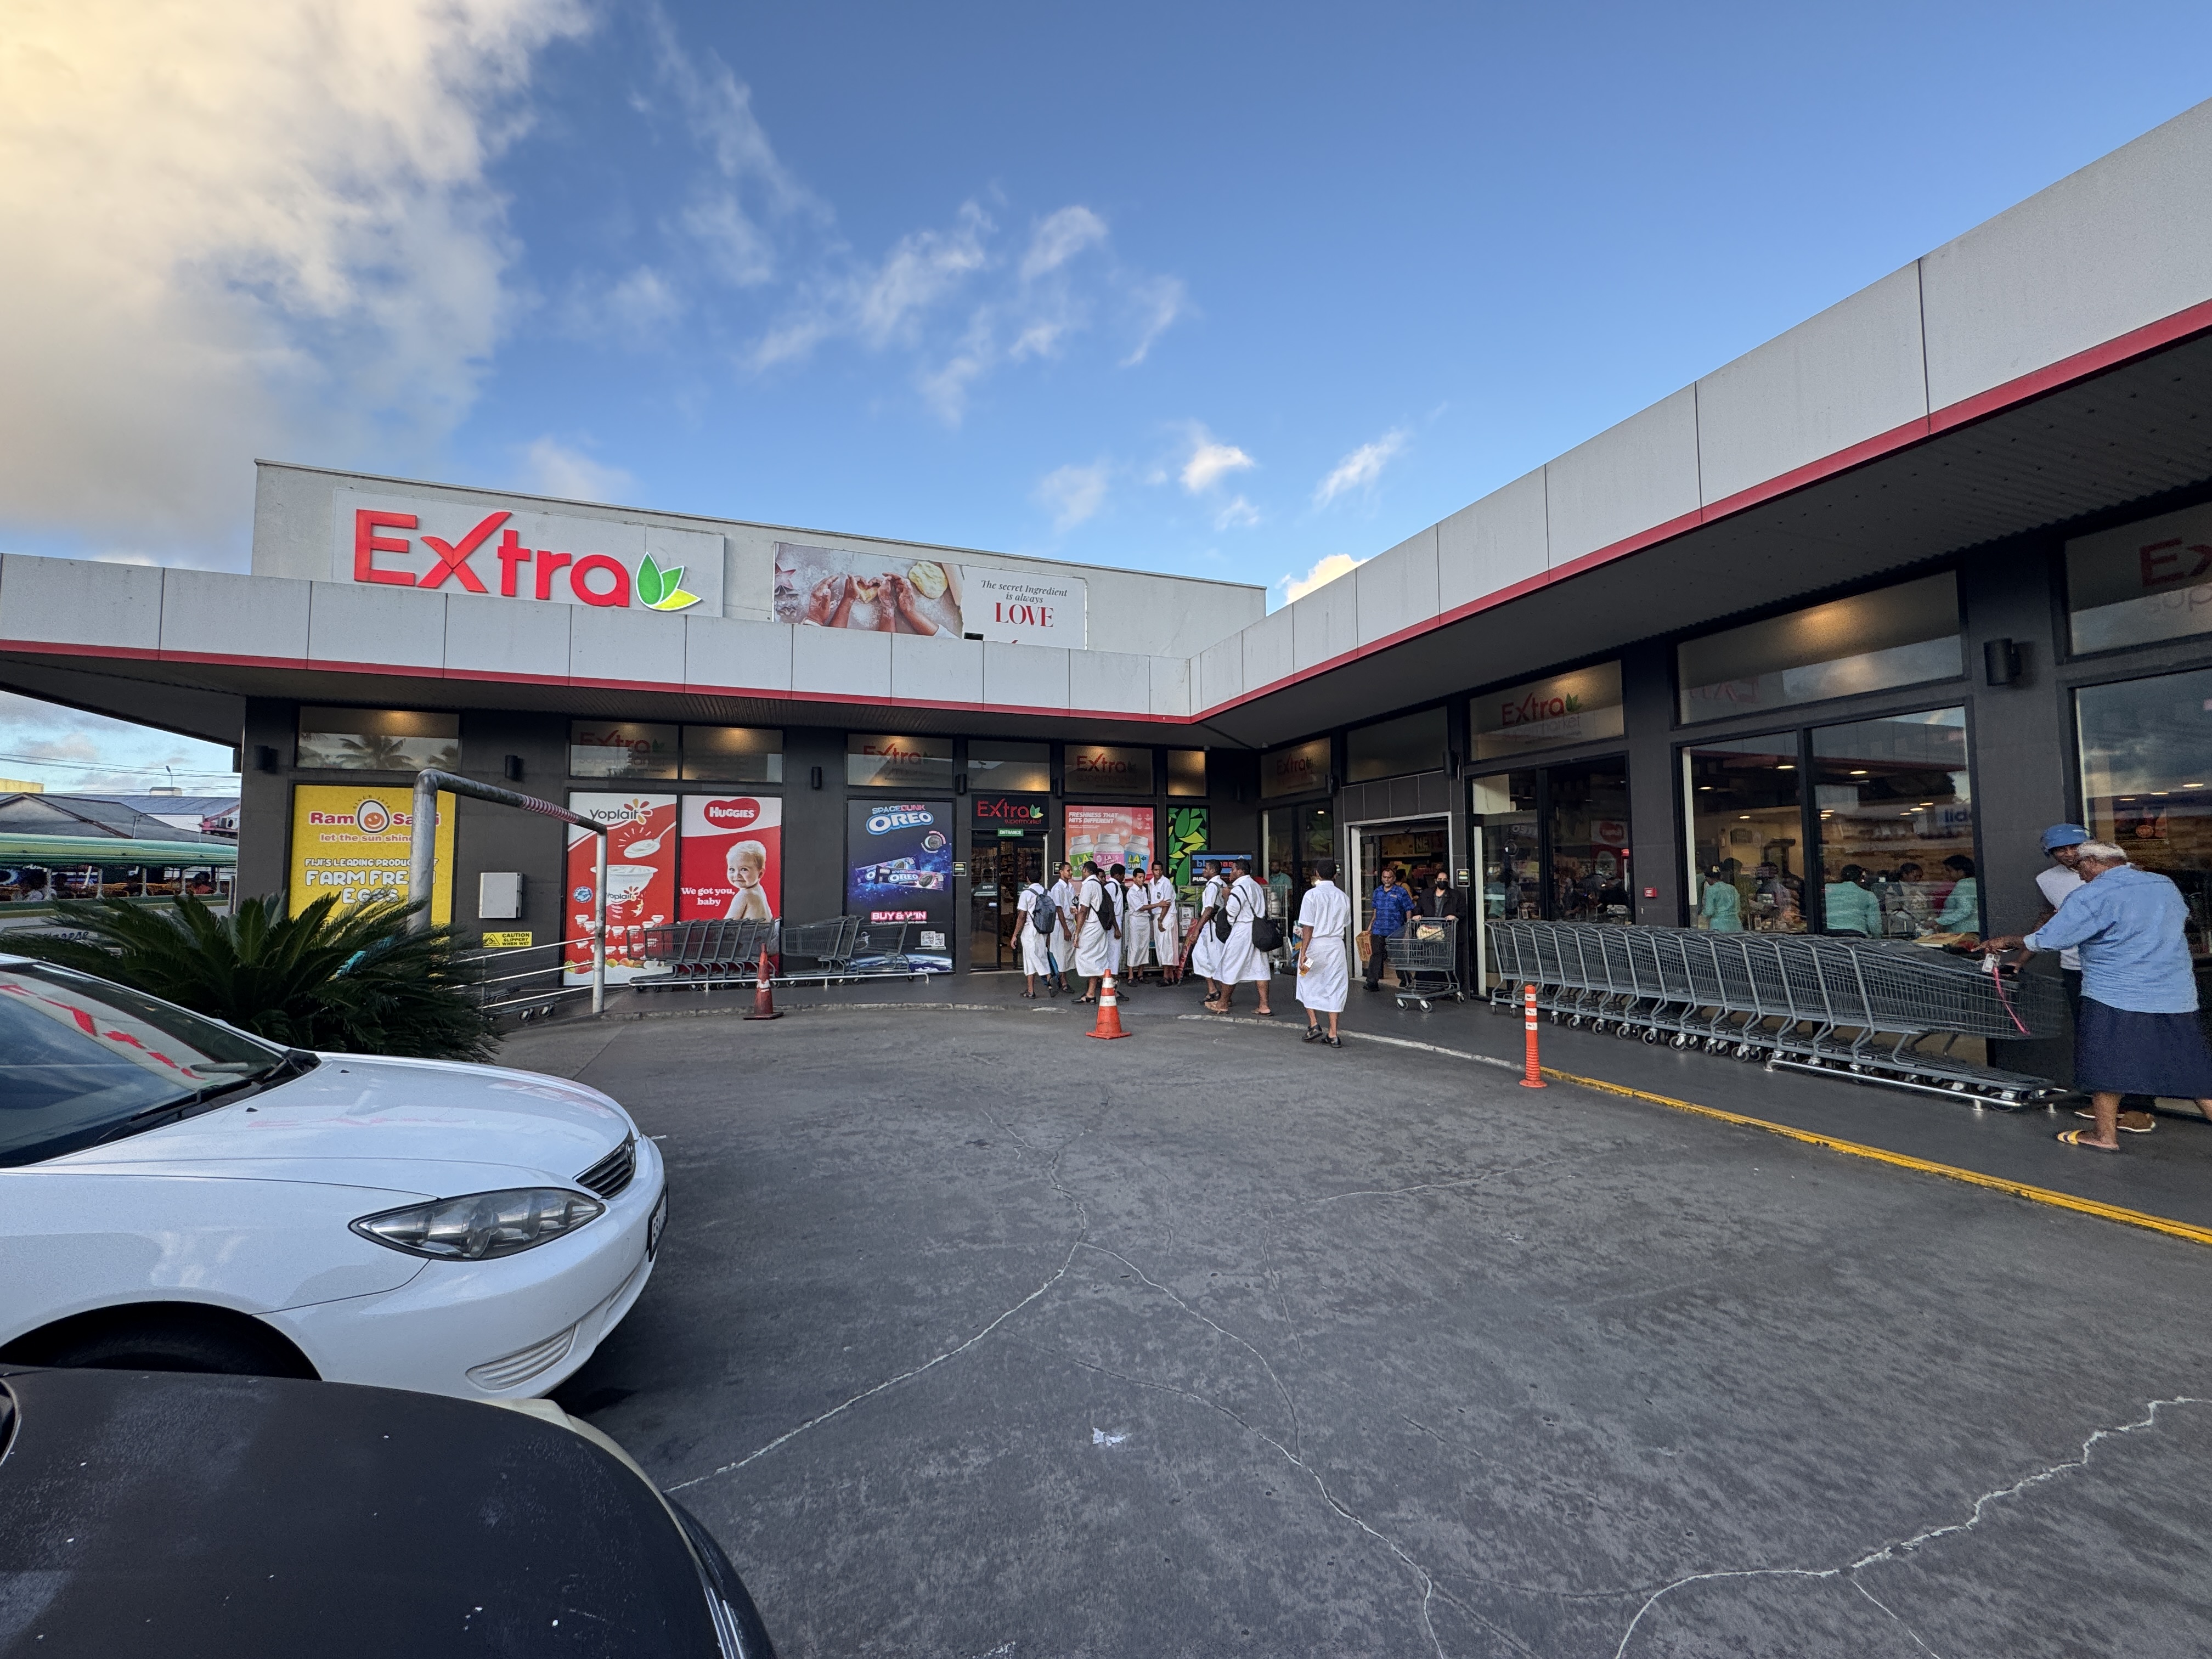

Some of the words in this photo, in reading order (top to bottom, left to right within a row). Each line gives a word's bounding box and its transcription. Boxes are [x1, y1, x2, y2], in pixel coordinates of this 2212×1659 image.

[354, 509, 630, 607] Extra
[981, 580, 996, 589] The
[998, 583, 1023, 592] secret
[1025, 585, 1068, 597] Ingredient
[1006, 592, 1013, 600] is
[1015, 593, 1043, 604] always
[995, 602, 1054, 628] LOVE
[1501, 692, 1564, 726] Extra
[1076, 753, 1127, 773] Extra
[709, 806, 755, 818] HUGGIES
[977, 798, 1030, 819] Extra
[311, 812, 354, 824] Ram
[589, 809, 639, 821] Yoplait
[869, 812, 932, 832] OREO
[1077, 854, 1089, 866] LA
[1128, 854, 1140, 863] LA
[306, 869, 366, 886] FARM
[889, 874, 919, 883] OREO
[697, 887, 714, 896] got
[714, 888, 736, 896] you,
[696, 897, 721, 907] baby
